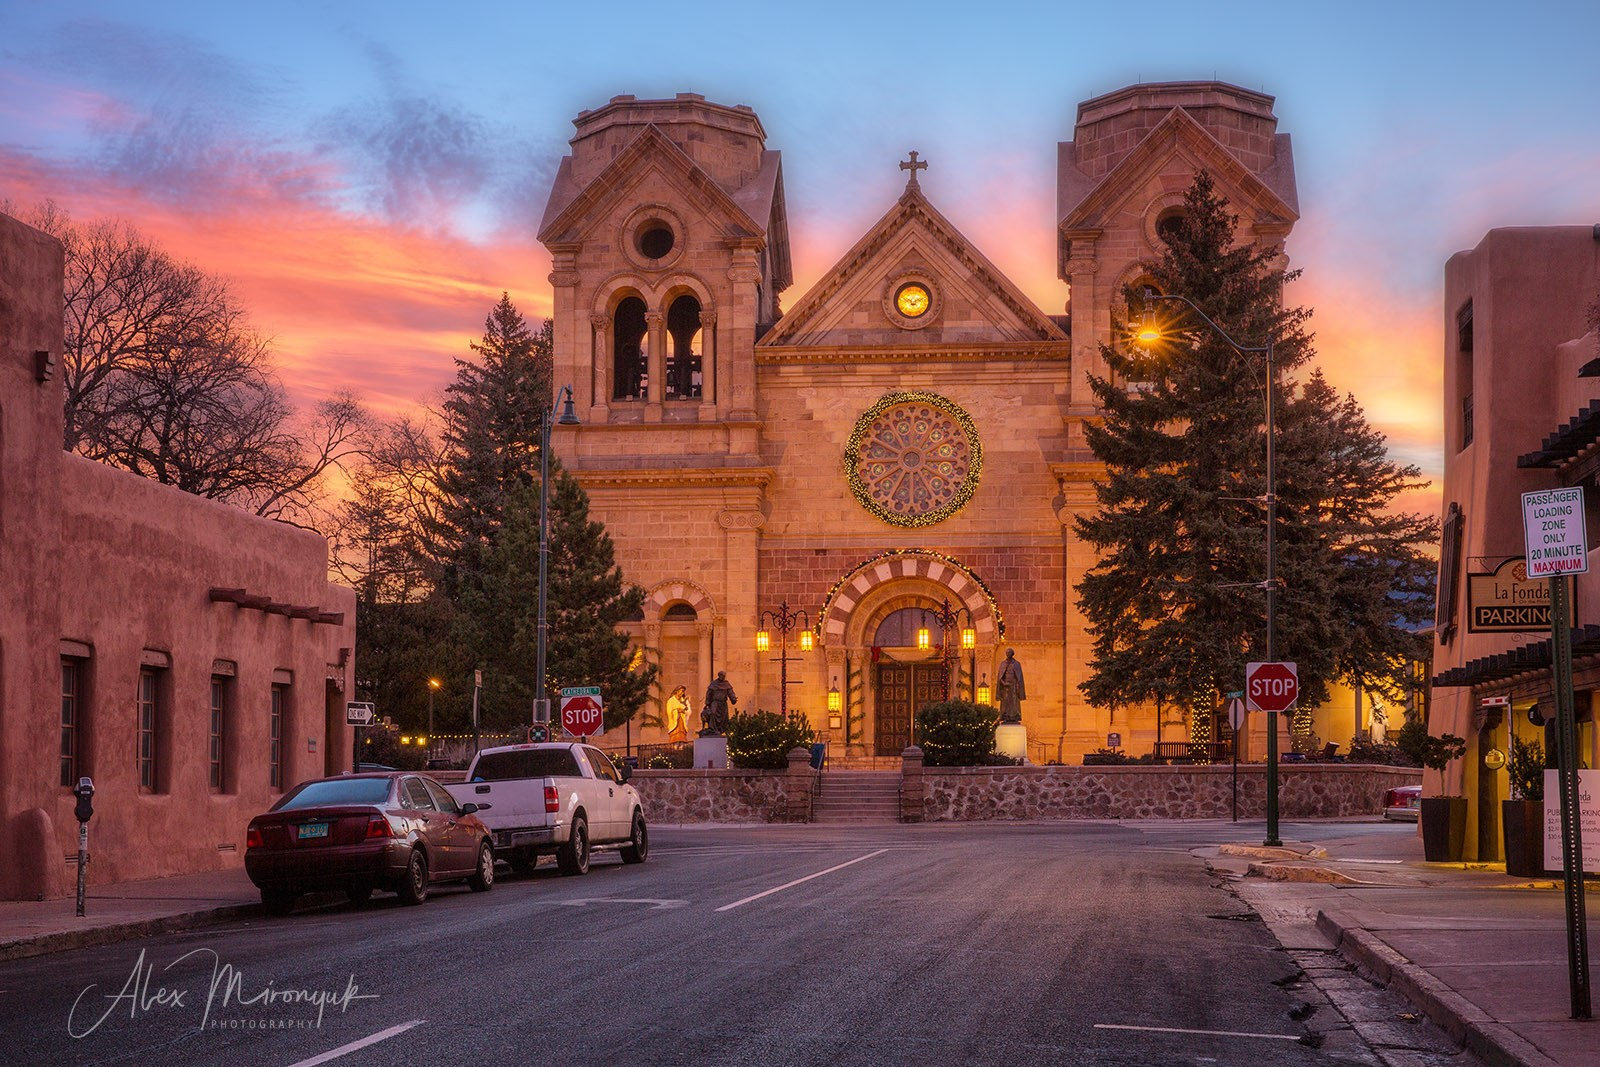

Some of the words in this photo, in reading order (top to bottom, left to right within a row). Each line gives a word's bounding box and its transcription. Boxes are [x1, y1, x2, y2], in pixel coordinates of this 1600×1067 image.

[1526, 491, 1578, 506] PASSENGER
[1534, 505, 1573, 519] LOADING
[1542, 519, 1566, 531] ZONE
[1543, 533, 1566, 544] ONLY
[1531, 549, 1542, 560] 20
[1544, 544, 1582, 558] MINUTE
[1534, 558, 1582, 573] MAXIMUM
[1495, 582, 1508, 600] La
[1512, 582, 1550, 603] Fonda
[1252, 679, 1294, 696] STOP
[349, 709, 357, 718] ONE
[357, 709, 366, 718] WAY
[566, 709, 598, 724] STOP
